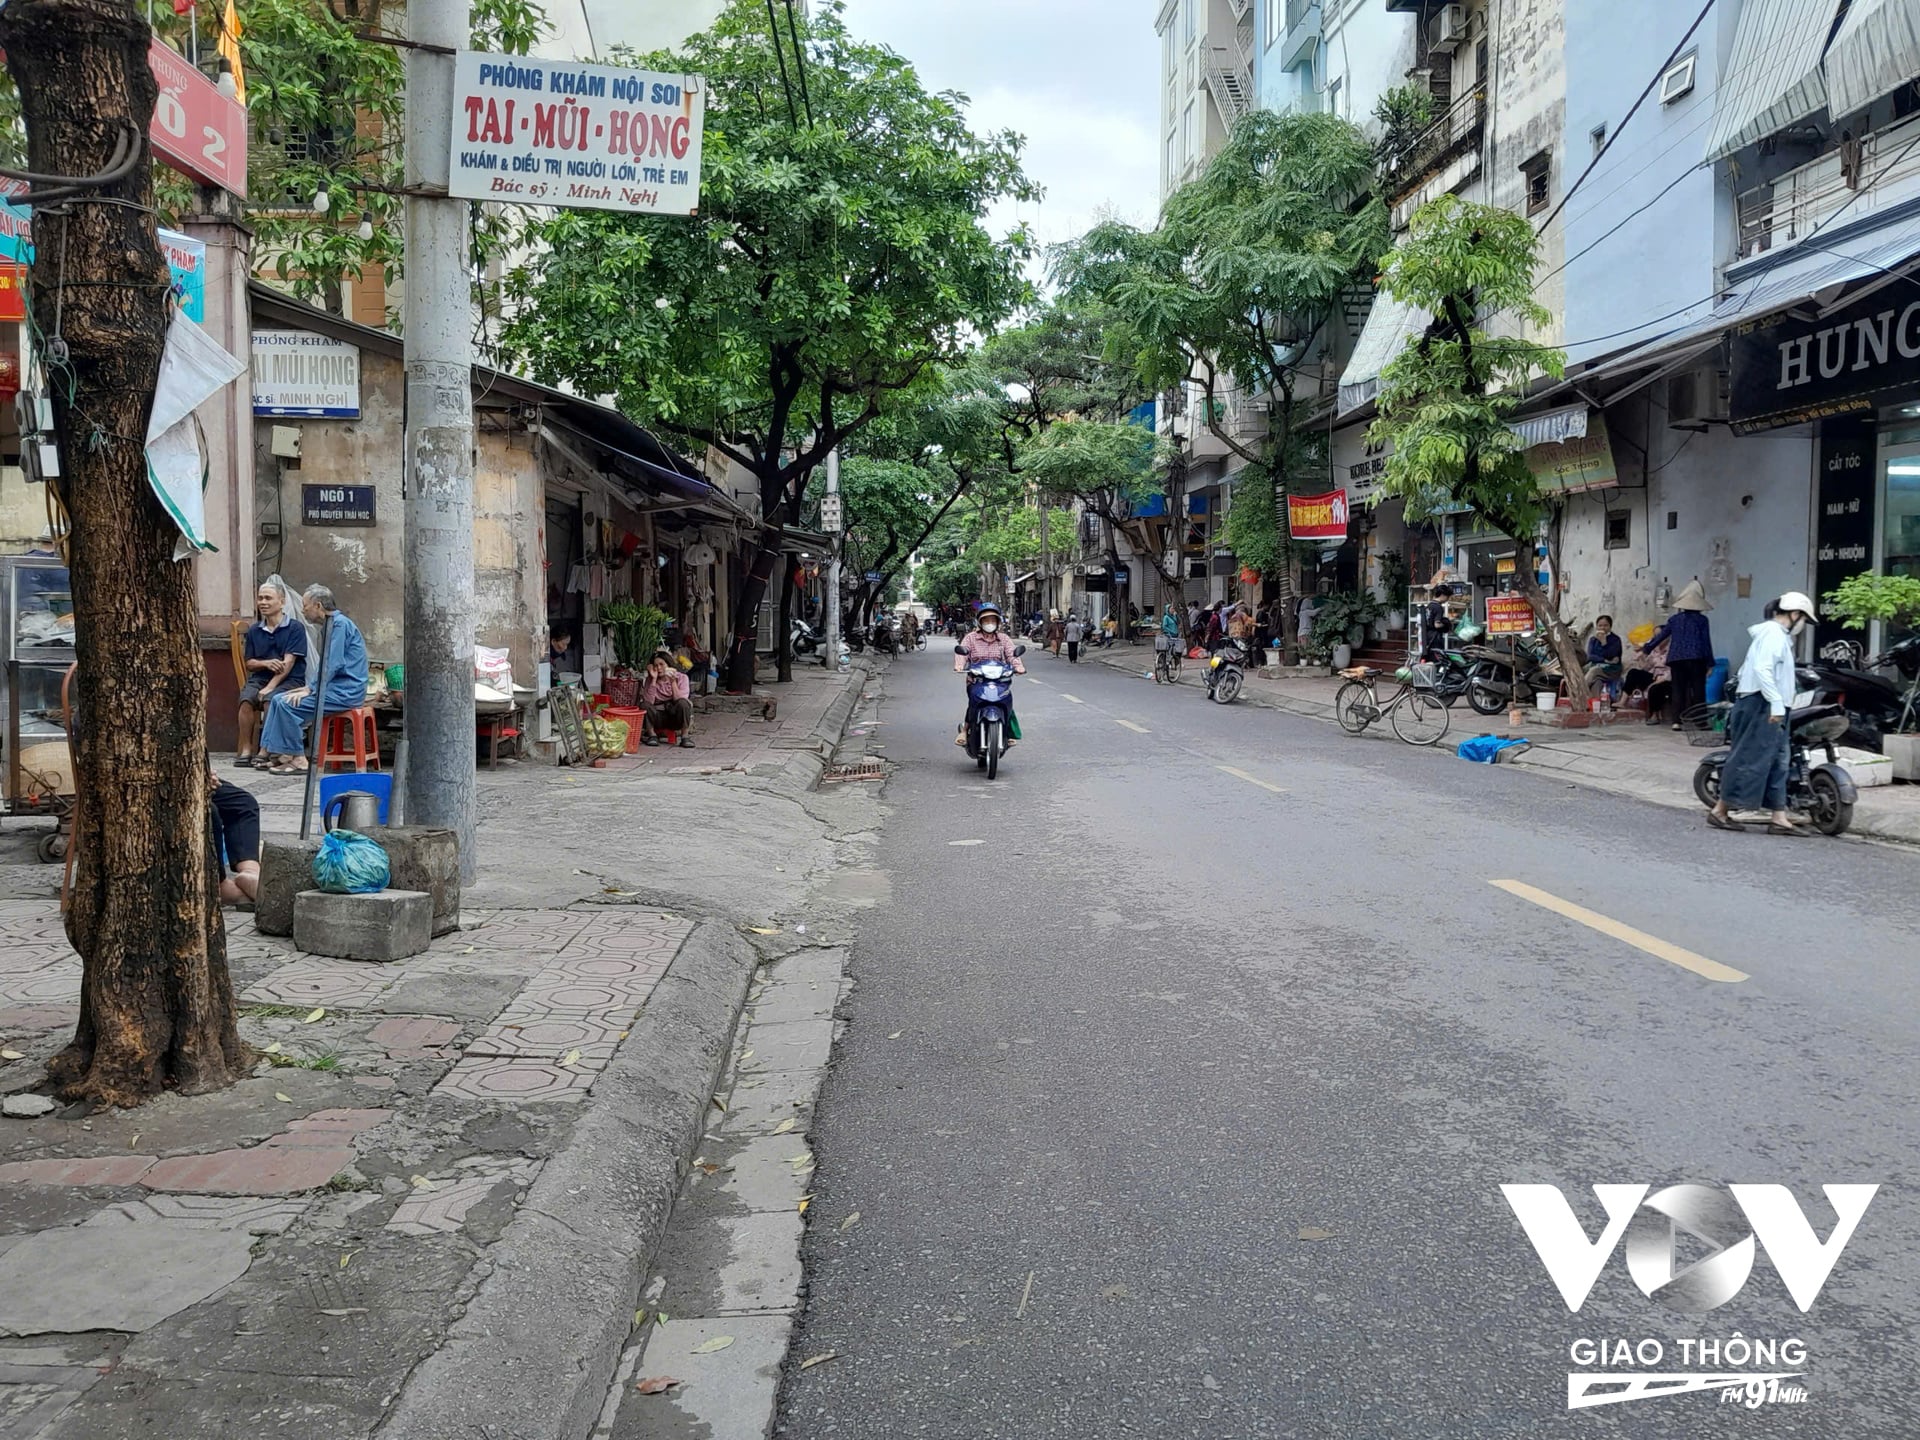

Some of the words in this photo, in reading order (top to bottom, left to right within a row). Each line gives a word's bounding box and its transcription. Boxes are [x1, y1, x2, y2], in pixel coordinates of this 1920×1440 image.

[479, 61, 543, 91] PHÒNG
[550, 70, 605, 98] KHÁM
[612, 75, 645, 104] NỘI
[651, 82, 681, 106] SOI
[464, 95, 515, 145] TAI
[532, 97, 590, 152] MŨI
[607, 110, 690, 164] HỌNG
[202, 125, 226, 169] 2
[460, 151, 497, 170] KHÁM
[500, 158, 508, 171] &
[512, 152, 540, 174] ĐIỀU
[544, 158, 562, 178] TRỊ
[567, 160, 606, 180] NGƯỜI
[643, 163, 665, 184] TRẺ
[670, 170, 689, 186] EM
[490, 177, 524, 193] Bác
[567, 184, 611, 201] Minh
[618, 188, 658, 208] Nghị
[273, 349, 305, 385] MŨI
[308, 355, 355, 390] HỌNG
[280, 392, 312, 405] MINH
[316, 391, 348, 408] NGHỊ
[1845, 452, 1861, 469] TÓC
[320, 486, 344, 503] NGÕ
[348, 490, 354, 503] 1
[320, 507, 343, 519] NGUYỄN
[344, 508, 357, 520] THÁI
[1827, 502, 1844, 515] NAM
[1819, 543, 1834, 561] UỐN
[1839, 543, 1865, 562] NHUỘM
